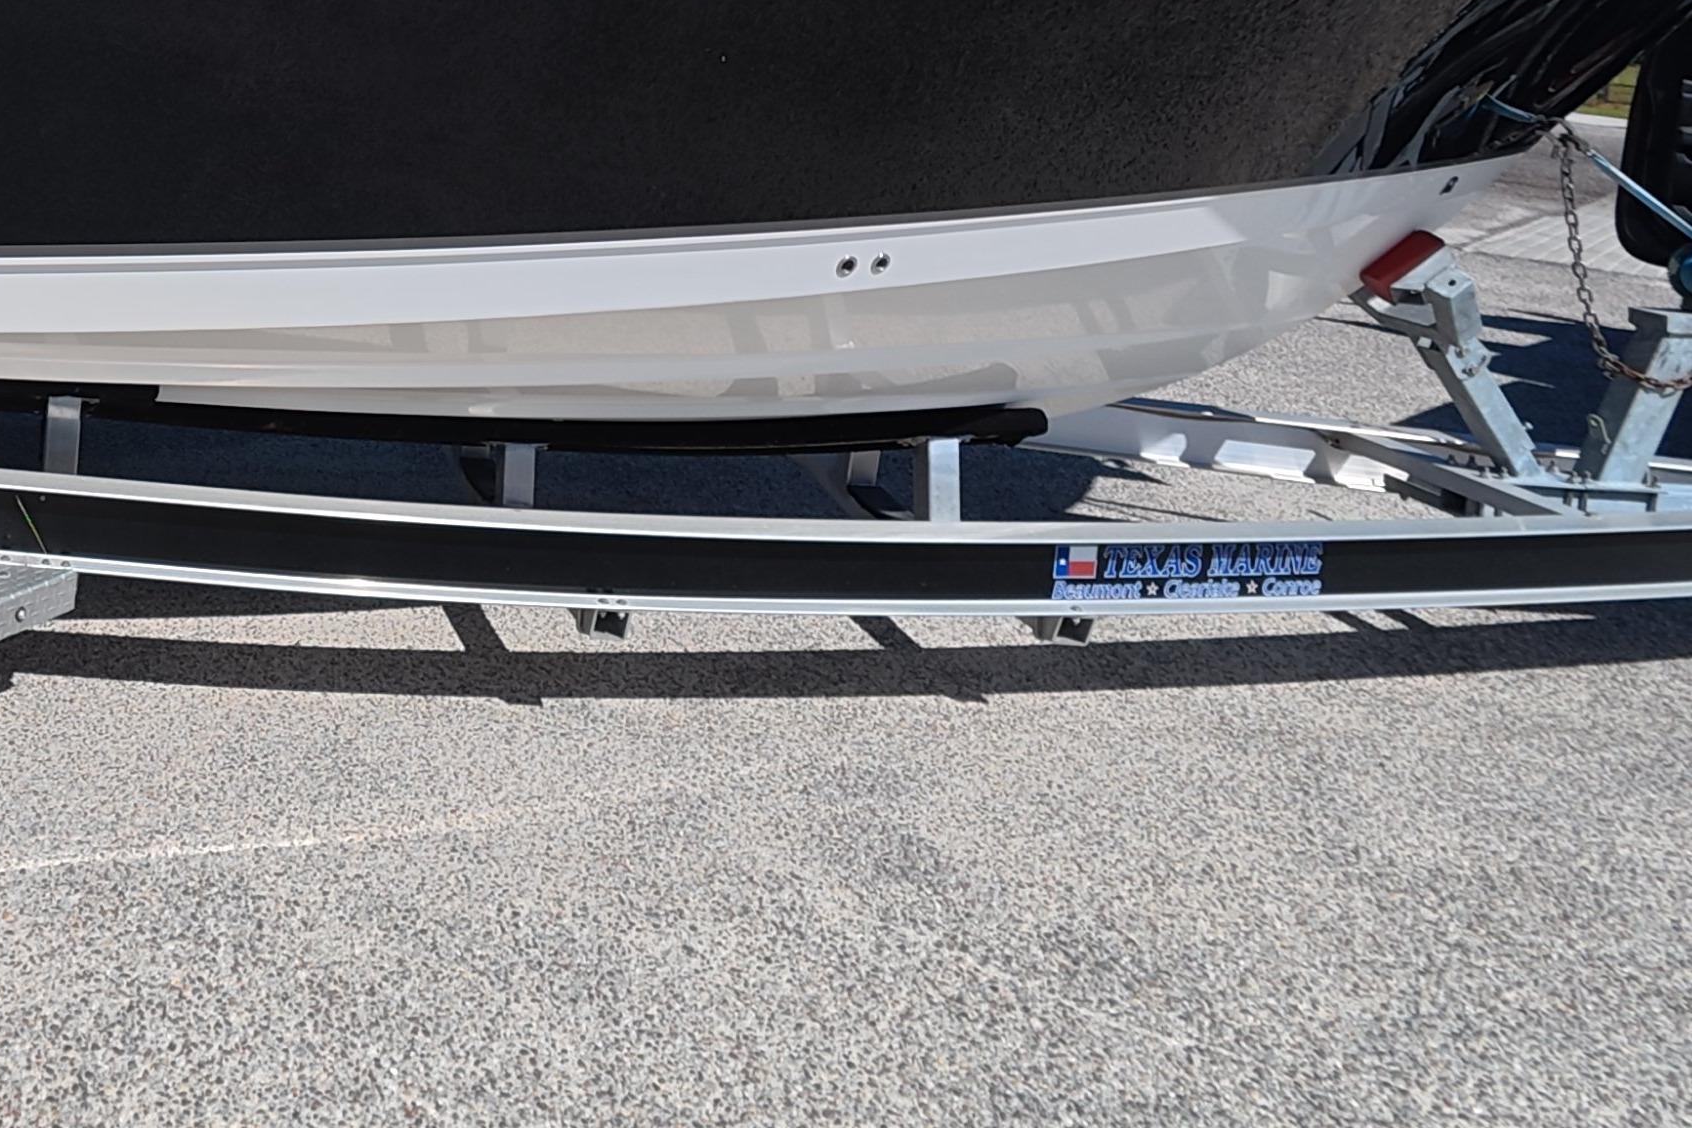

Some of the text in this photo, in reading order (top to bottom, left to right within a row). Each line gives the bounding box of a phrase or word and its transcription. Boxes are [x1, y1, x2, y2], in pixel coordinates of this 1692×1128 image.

[1103, 541, 1324, 578] TEXAS MARINE
[1052, 580, 1142, 600] Beaumont
[1261, 577, 1322, 597] Conroe
